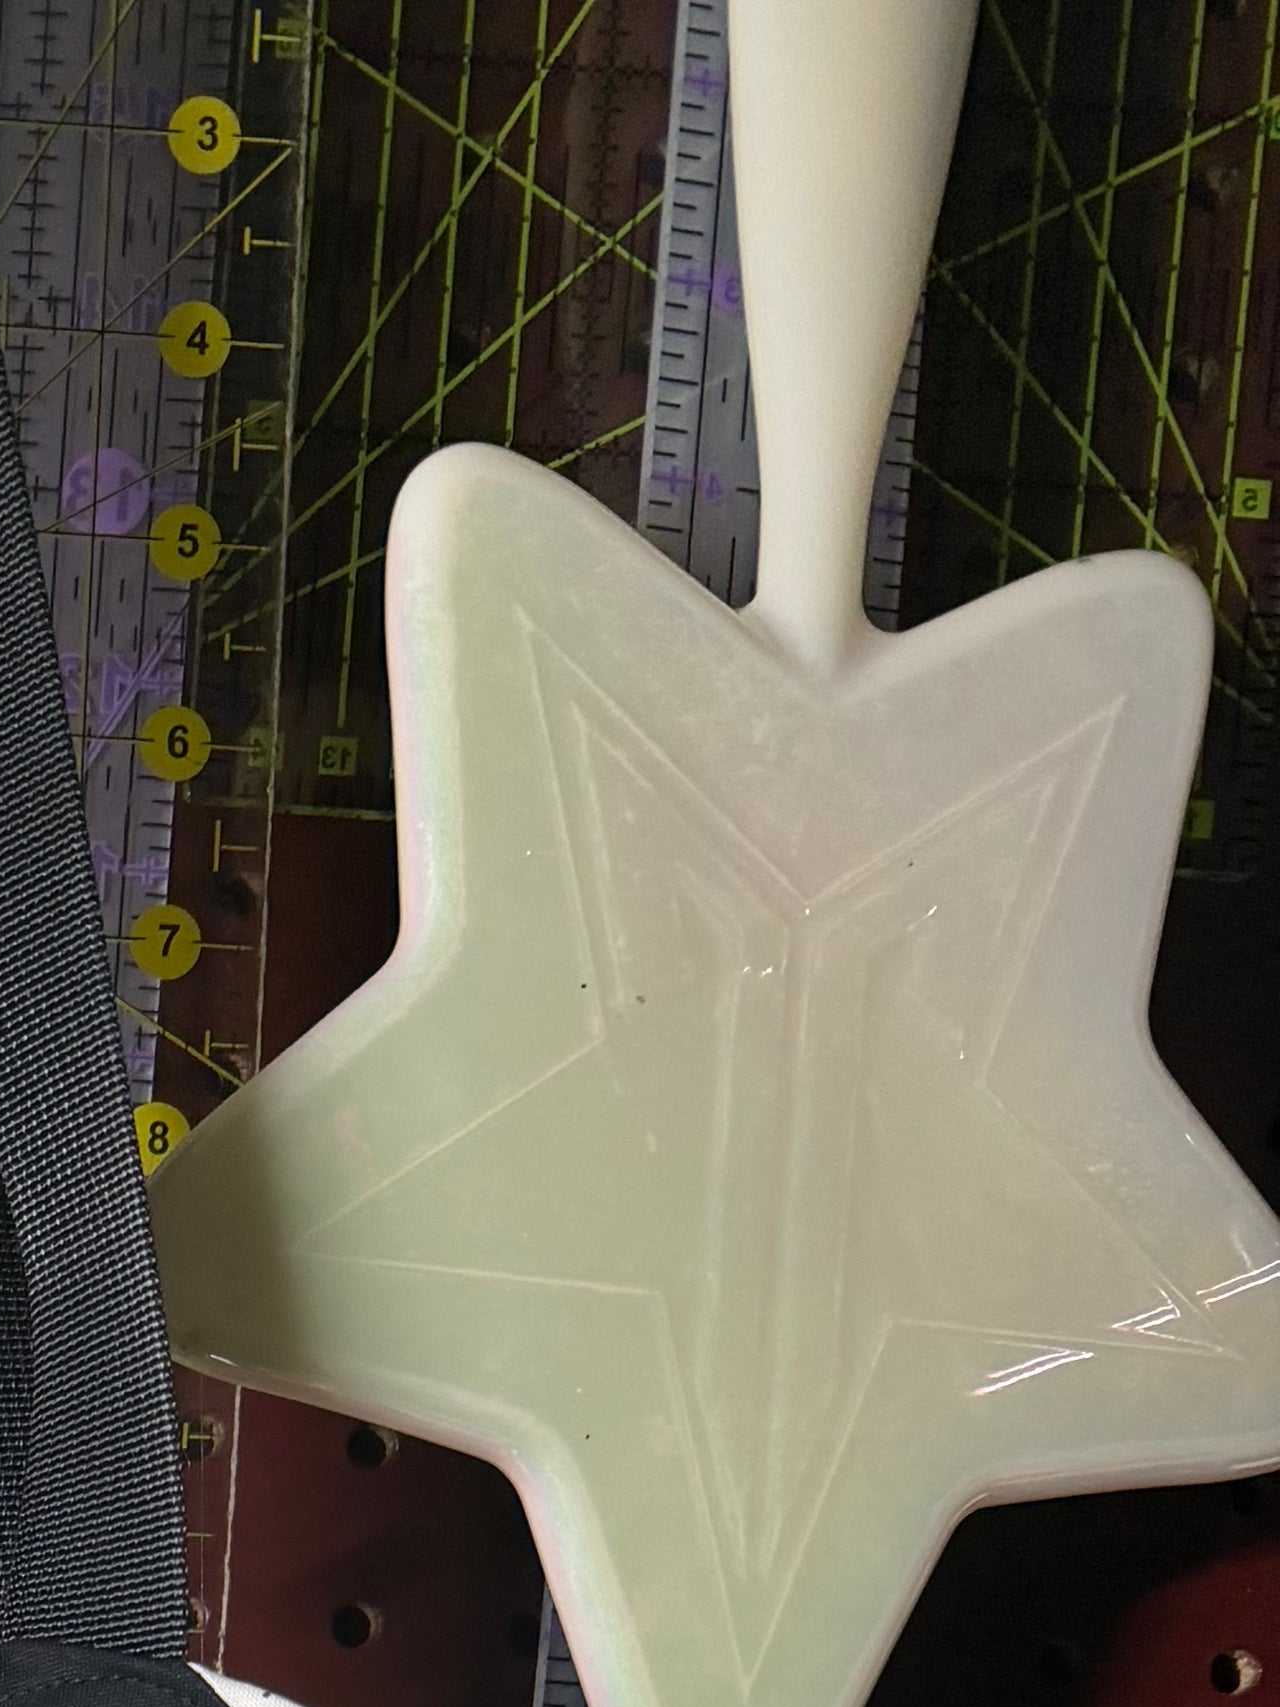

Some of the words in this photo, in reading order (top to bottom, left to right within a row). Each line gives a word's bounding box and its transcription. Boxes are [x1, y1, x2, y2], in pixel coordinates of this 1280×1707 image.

[196, 116, 219, 151] 3
[186, 321, 210, 356] 4
[178, 523, 200, 558] 5
[167, 725, 189, 759] 6
[158, 924, 180, 957] 7
[149, 1120, 170, 1155] 8
